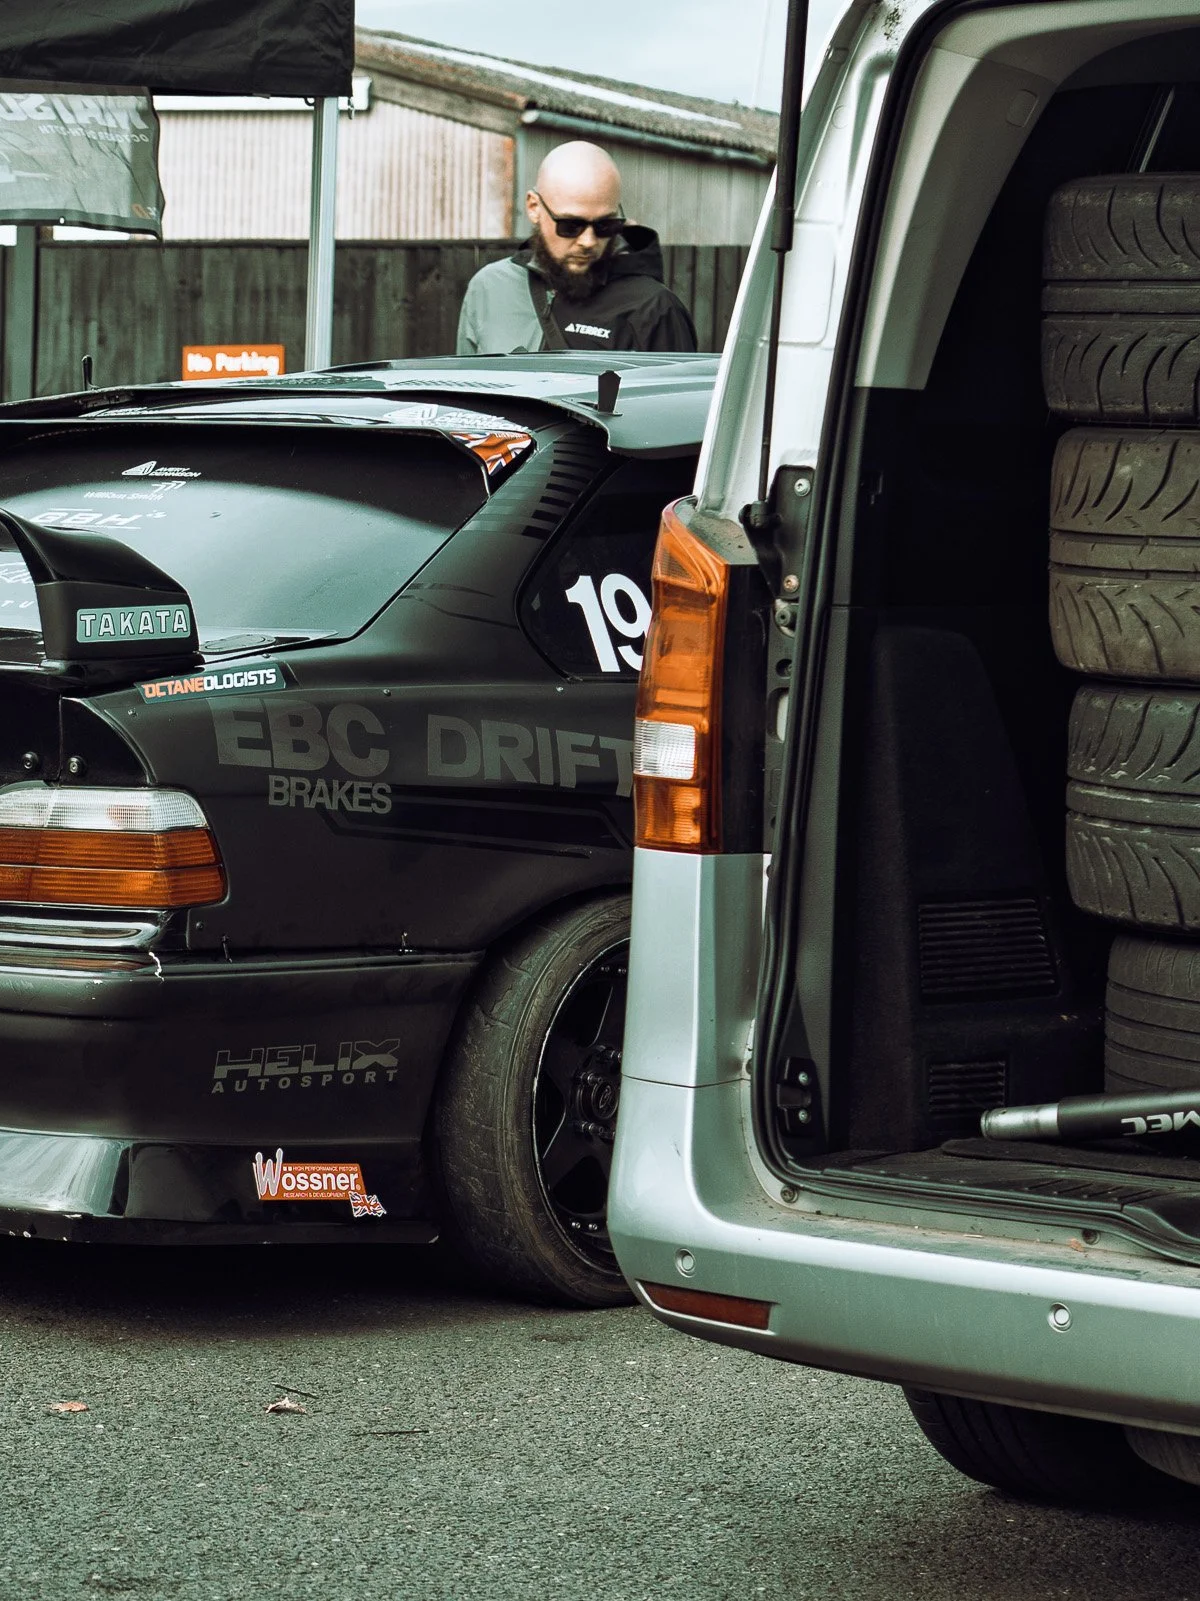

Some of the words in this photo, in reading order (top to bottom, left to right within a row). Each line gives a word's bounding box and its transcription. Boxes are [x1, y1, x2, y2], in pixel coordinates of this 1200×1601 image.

[575, 323, 611, 339] TERREX
[187, 353, 212, 372] No
[216, 351, 280, 376] Parking
[79, 609, 188, 637] TAKATA
[565, 573, 652, 672] 19
[141, 668, 277, 699] OCTANEOLOGISTS
[210, 698, 390, 778] EBC
[268, 775, 392, 814] BRAKES
[214, 1039, 400, 1079] HELIX
[212, 1070, 397, 1094] AUTOSPORT
